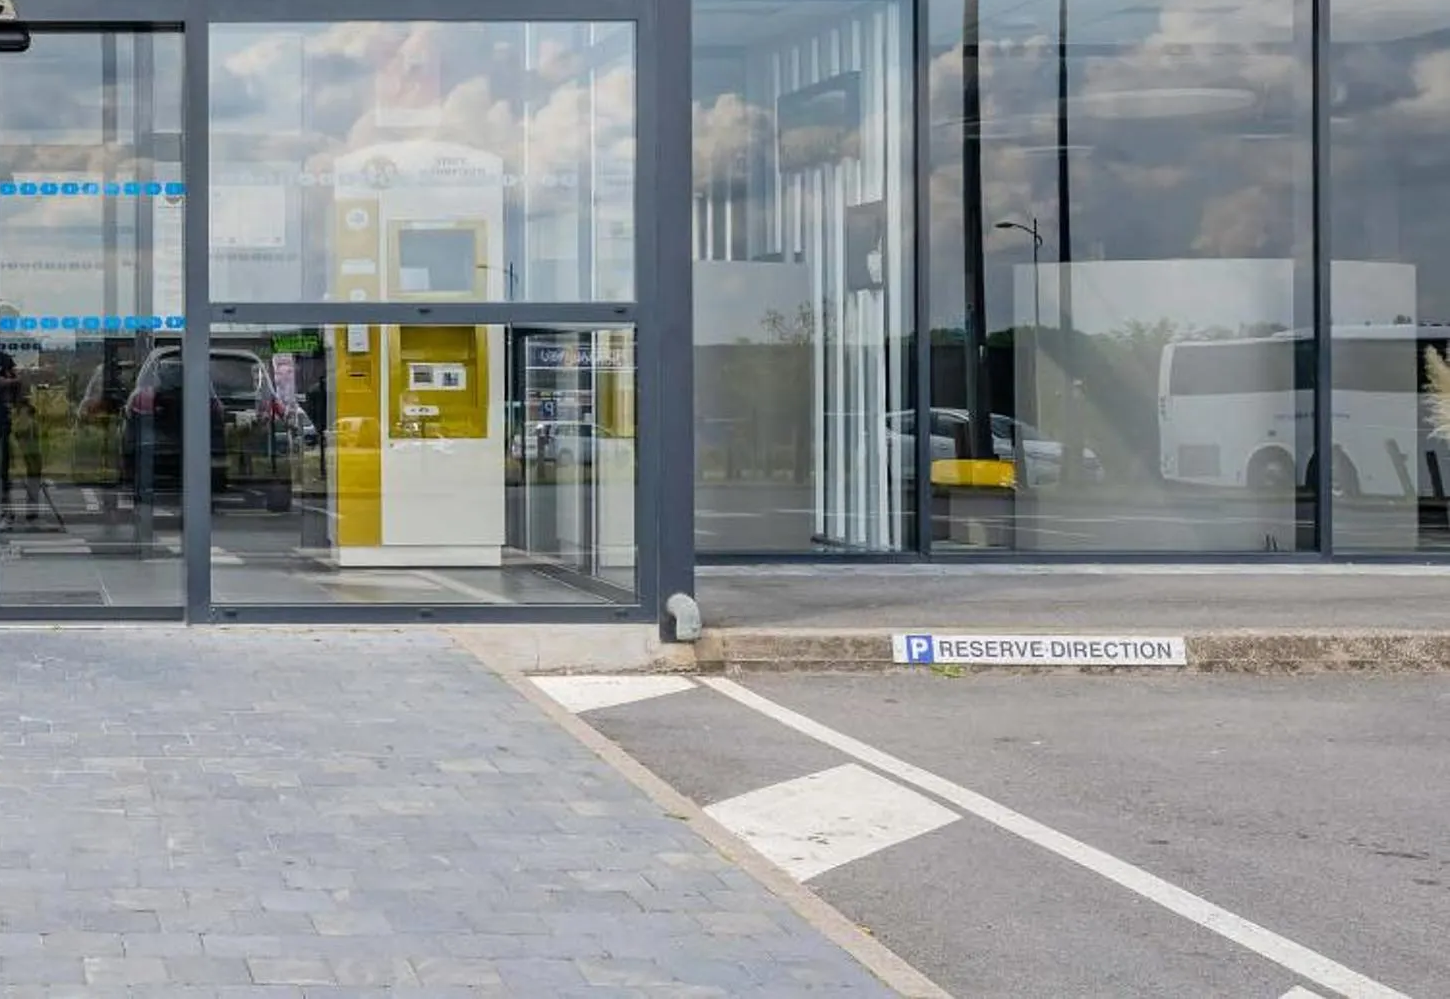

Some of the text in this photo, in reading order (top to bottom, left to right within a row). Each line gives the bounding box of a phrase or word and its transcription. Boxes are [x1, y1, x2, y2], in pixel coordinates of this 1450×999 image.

[910, 638, 1172, 659] P RESERVE DIRECTION
